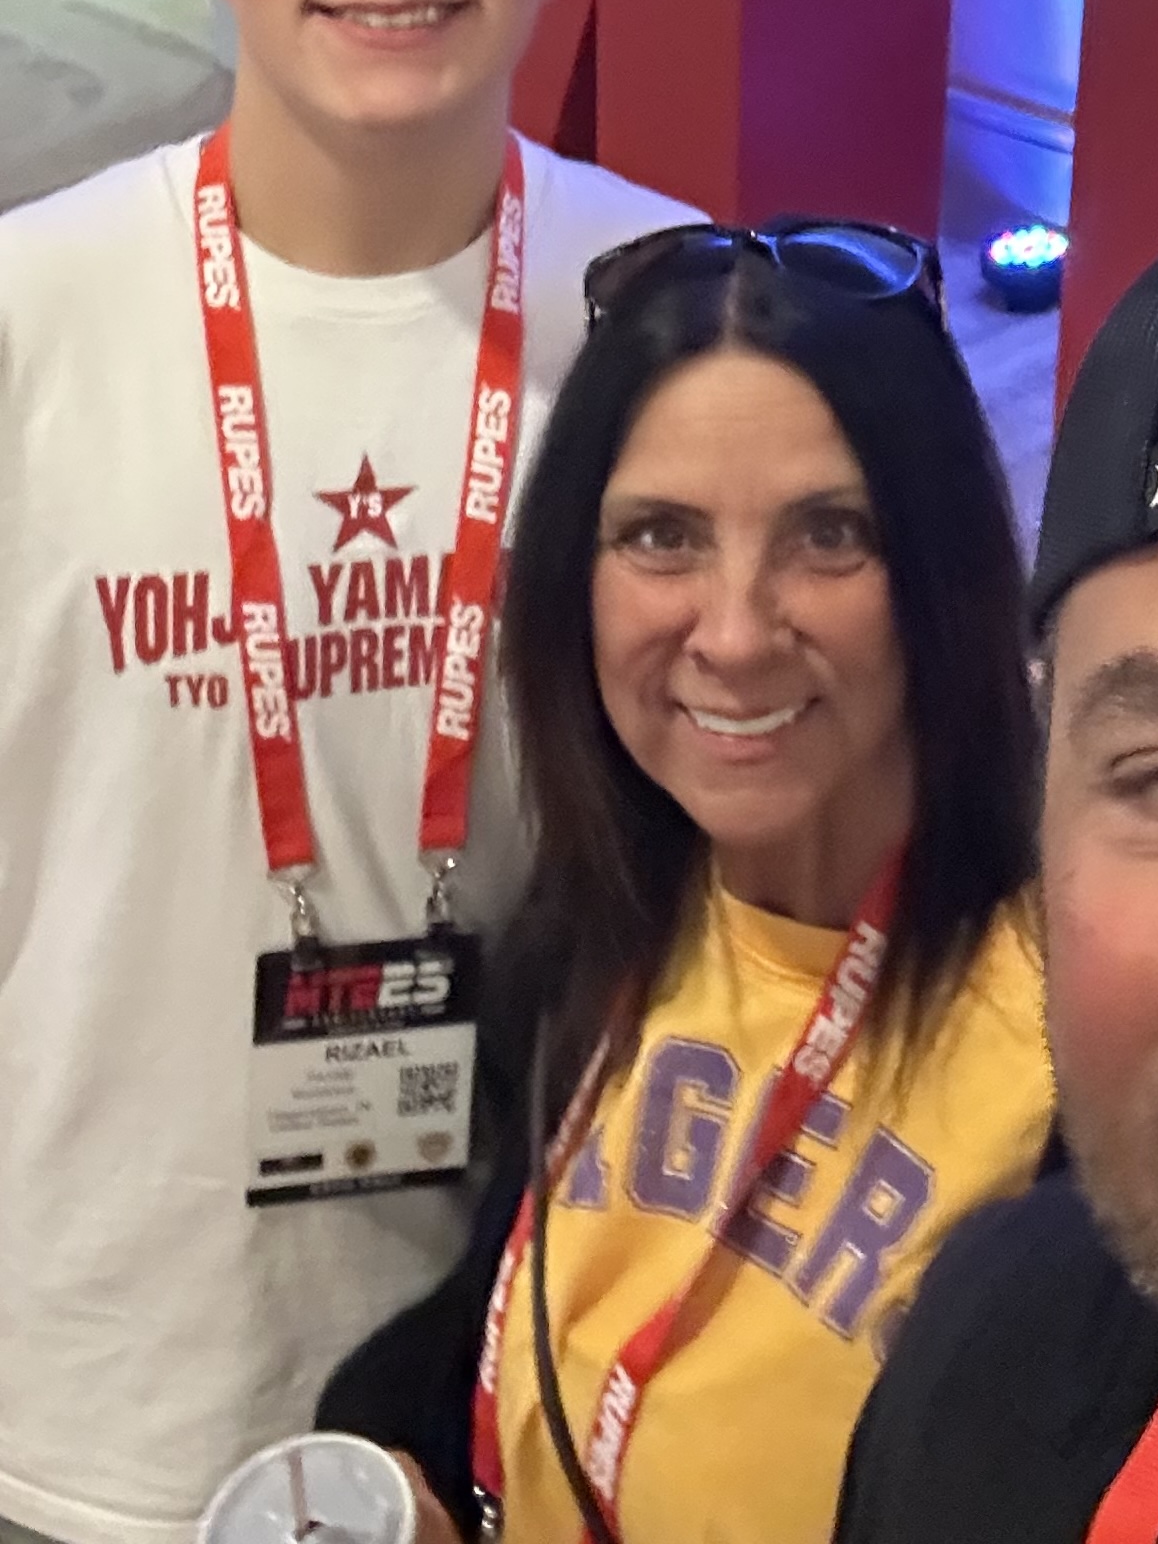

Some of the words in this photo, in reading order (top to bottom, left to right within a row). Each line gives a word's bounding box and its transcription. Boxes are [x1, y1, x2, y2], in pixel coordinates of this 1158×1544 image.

[197, 183, 241, 312] RUPES
[489, 186, 524, 316] RUPES
[217, 384, 266, 520] RUPES
[464, 382, 512, 525] RUPES
[95, 570, 236, 674] YOHJ
[308, 552, 456, 627] YAM
[164, 674, 229, 709] TYO
[286, 625, 444, 702] UPREM
[240, 601, 292, 744] RUPES
[436, 598, 484, 742] RUPES
[556, 1035, 937, 1363] GER
